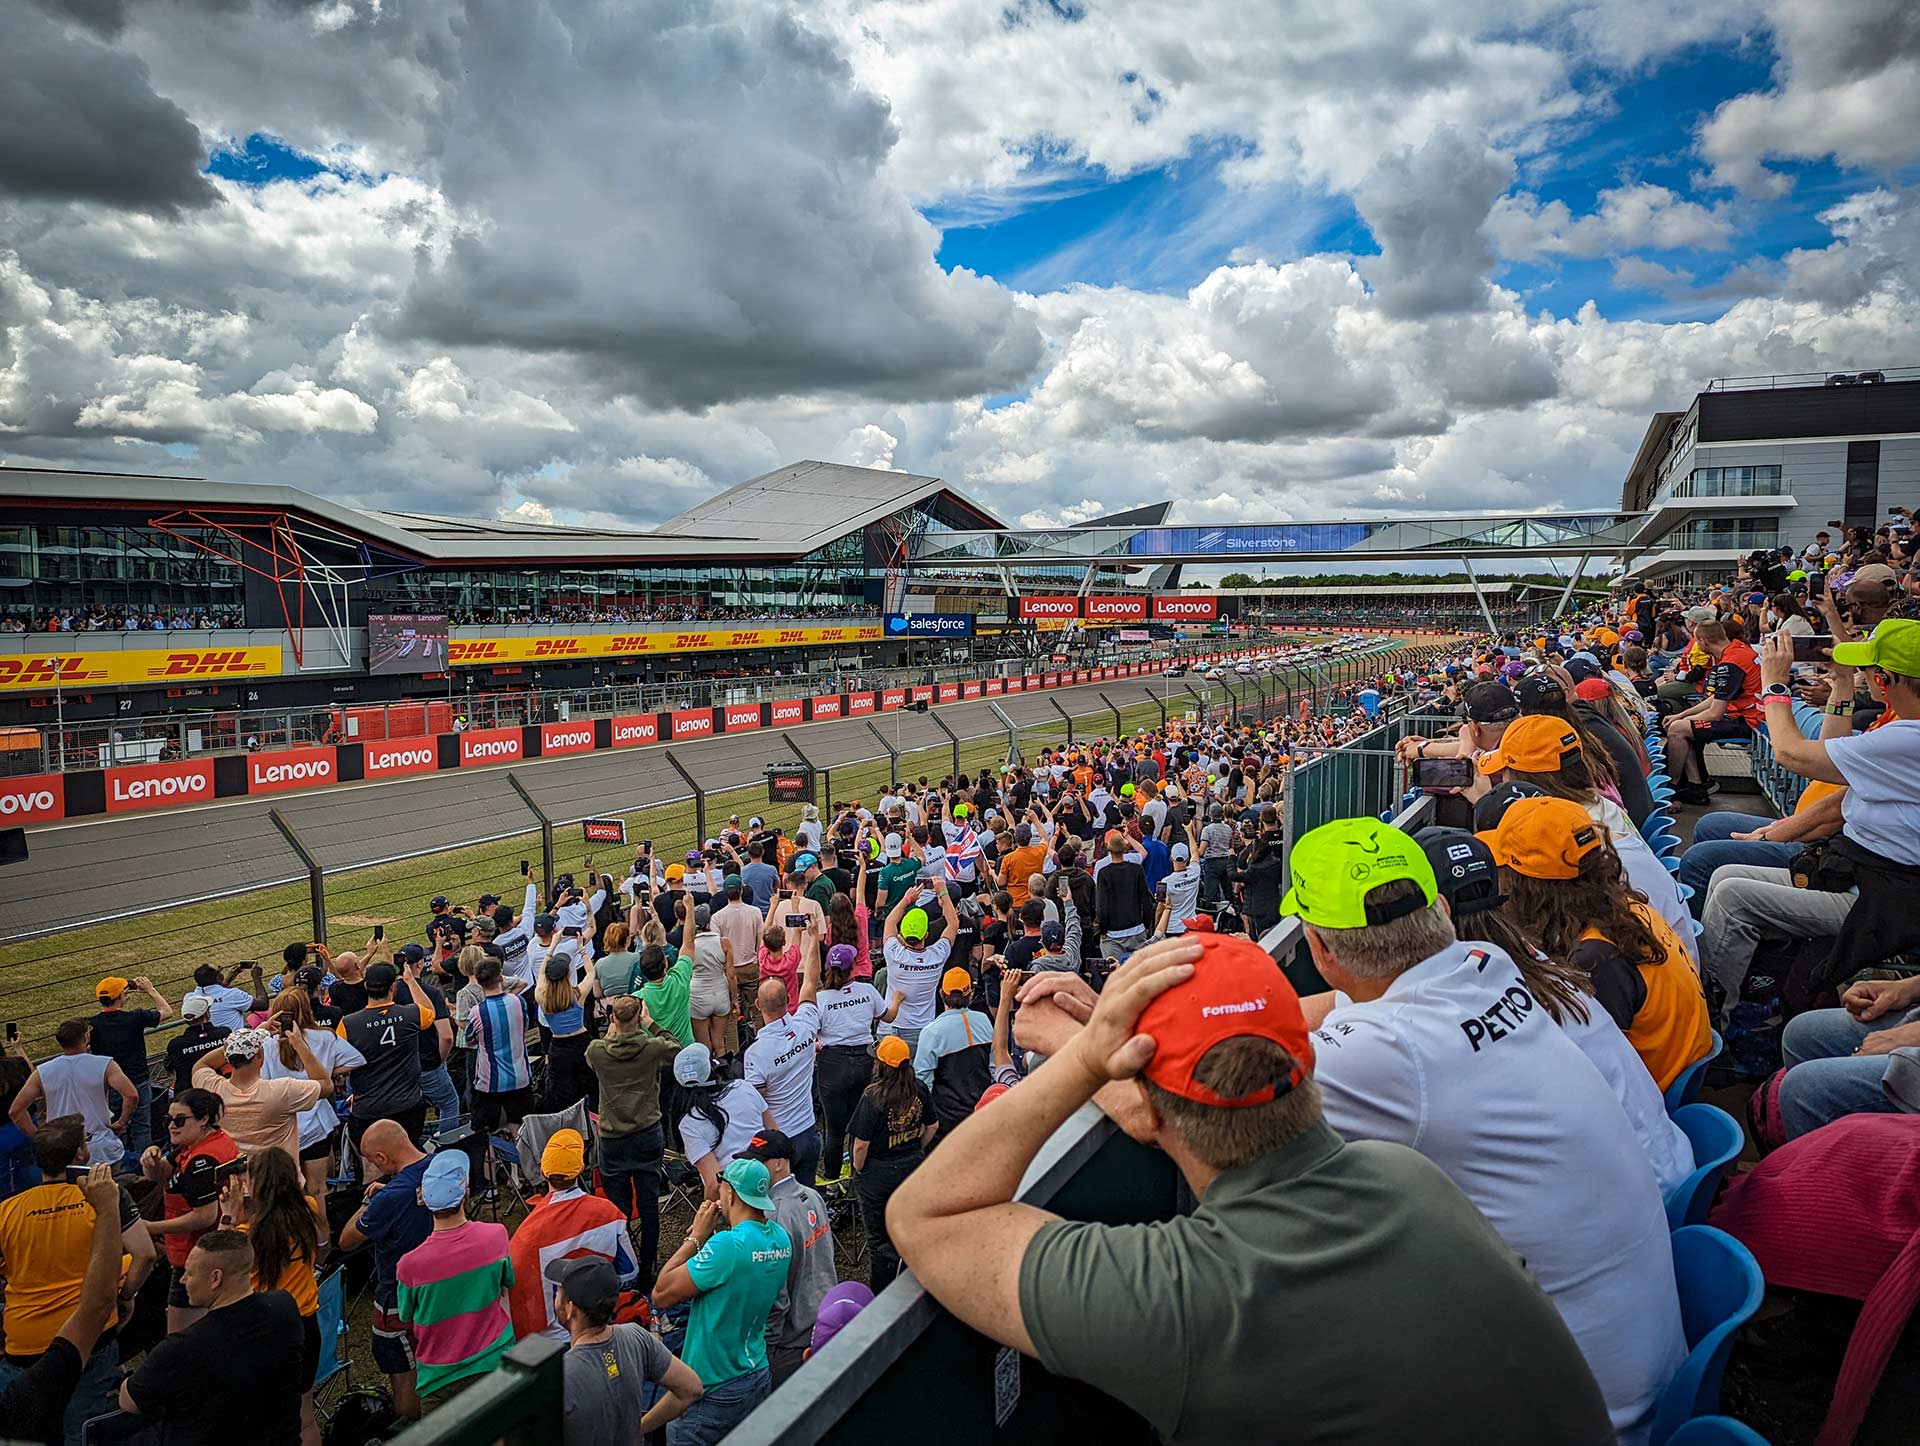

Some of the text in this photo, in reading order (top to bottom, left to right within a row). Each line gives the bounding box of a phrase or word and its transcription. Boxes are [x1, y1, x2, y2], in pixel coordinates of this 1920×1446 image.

[1226, 537, 1296, 548] Silverstone
[1024, 600, 1073, 613] Lenovo
[1089, 601, 1141, 613] Lenovo
[1157, 600, 1211, 613] Lenovo
[910, 619, 965, 632] salesforce
[732, 632, 760, 645] DHL
[780, 631, 804, 643] DHL
[821, 630, 843, 641] DHL
[859, 628, 878, 639] DHL
[611, 637, 650, 651] DHL
[676, 634, 708, 648] DHL
[449, 642, 499, 659] DHL
[535, 640, 579, 656] DHL
[165, 652, 251, 675] DHL
[0, 658, 89, 683] DHL
[940, 688, 957, 697] Lenovo
[964, 685, 980, 694] Lenovo
[987, 682, 1001, 691] Lenovo
[248, 692, 259, 700] 26
[851, 697, 873, 708] Lenovo
[883, 695, 904, 705] Lenovo
[913, 692, 932, 701] Lenovo
[120, 700, 132, 710] 27
[814, 701, 839, 713] Lenovo
[727, 712, 758, 725] Lenovo
[773, 706, 800, 719] Lenovo
[675, 718, 710, 733] Lenovo
[615, 725, 654, 740] Lenovo
[546, 731, 591, 748] Lenovo
[465, 739, 518, 758] Lenovo
[369, 747, 433, 770] Lenovo
[254, 758, 331, 784] Lenovo
[113, 773, 206, 801] Lenovo
[0, 790, 55, 815] ovo
[589, 828, 618, 837] Lenovo
[956, 927, 973, 935] ONAS
[505, 939, 526, 954] Dickies
[899, 963, 939, 971] PETRONAS
[827, 995, 870, 1011] PETRONAS
[1202, 1003, 1256, 1018] Formula
[366, 1015, 404, 1029] NORRIS
[379, 1025, 397, 1046] 4
[182, 1036, 227, 1055] PETRONAS
[26, 1202, 84, 1217] McLaren
[752, 1247, 792, 1263] PETRONAS
